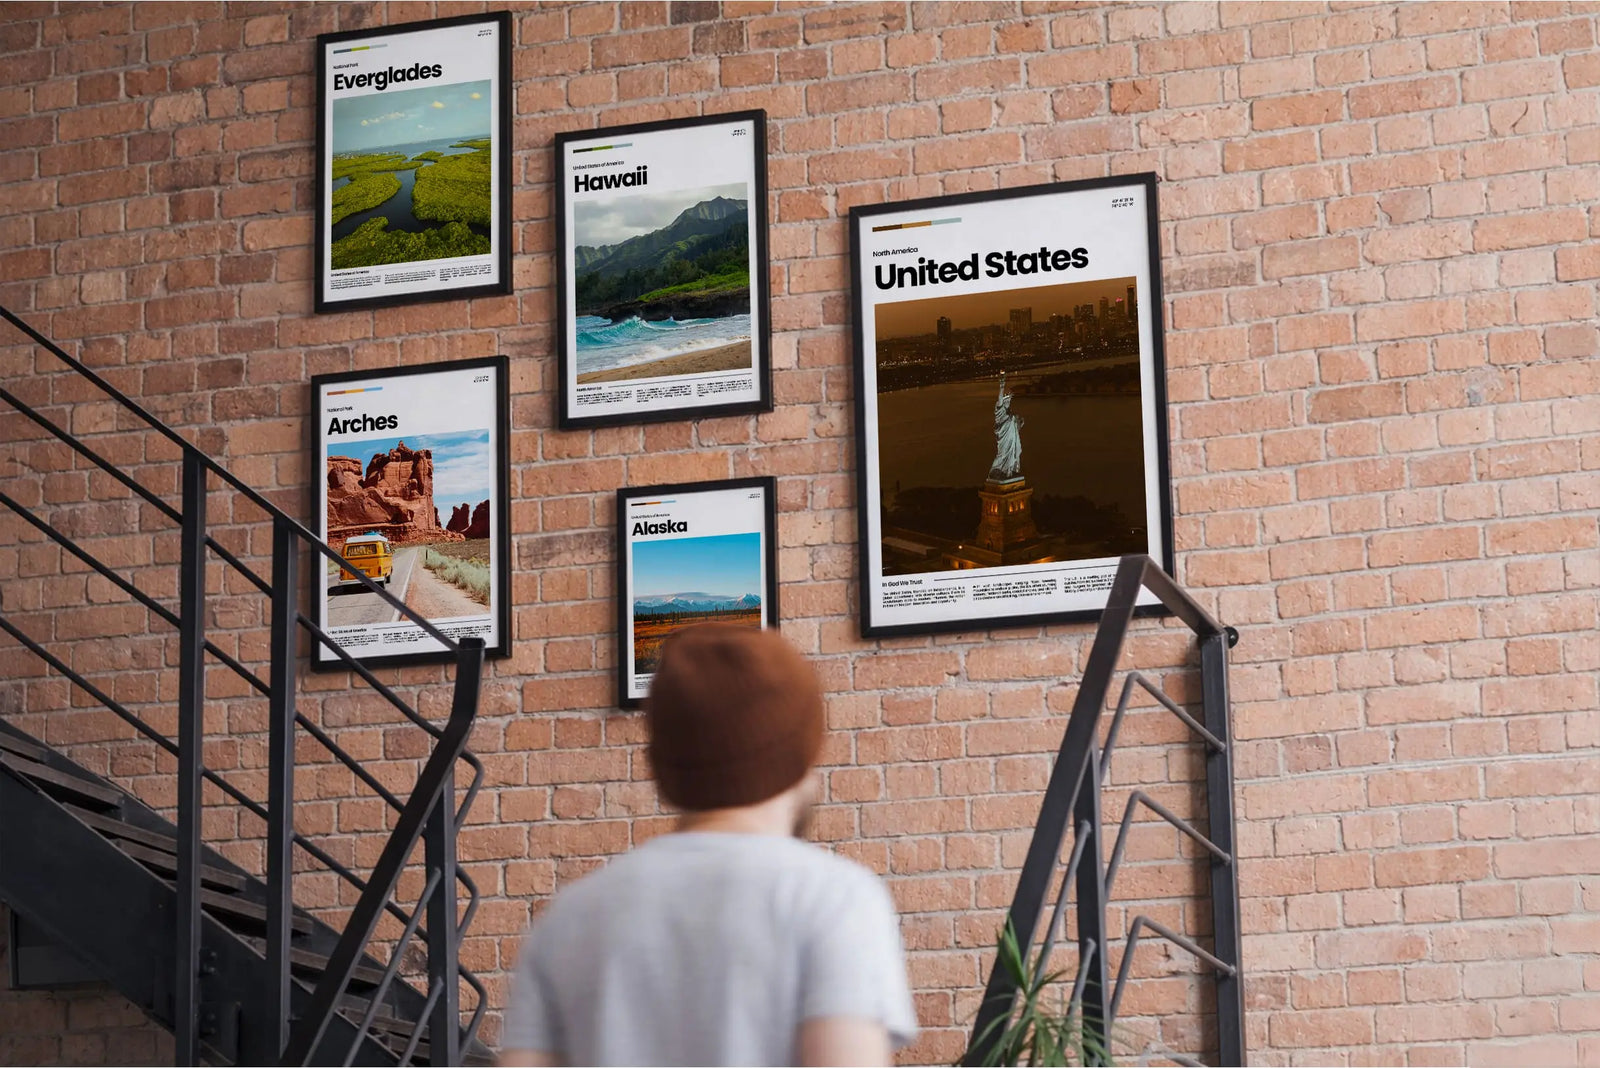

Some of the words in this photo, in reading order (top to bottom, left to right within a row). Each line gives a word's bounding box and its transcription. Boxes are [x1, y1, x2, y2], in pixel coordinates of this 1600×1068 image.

[334, 62, 442, 91] Everglades
[574, 165, 648, 193] Hawaii
[890, 246, 918, 255] America
[874, 252, 980, 290] United
[984, 246, 1089, 278] States
[327, 413, 398, 436] Arches
[632, 519, 688, 536] Alaska
